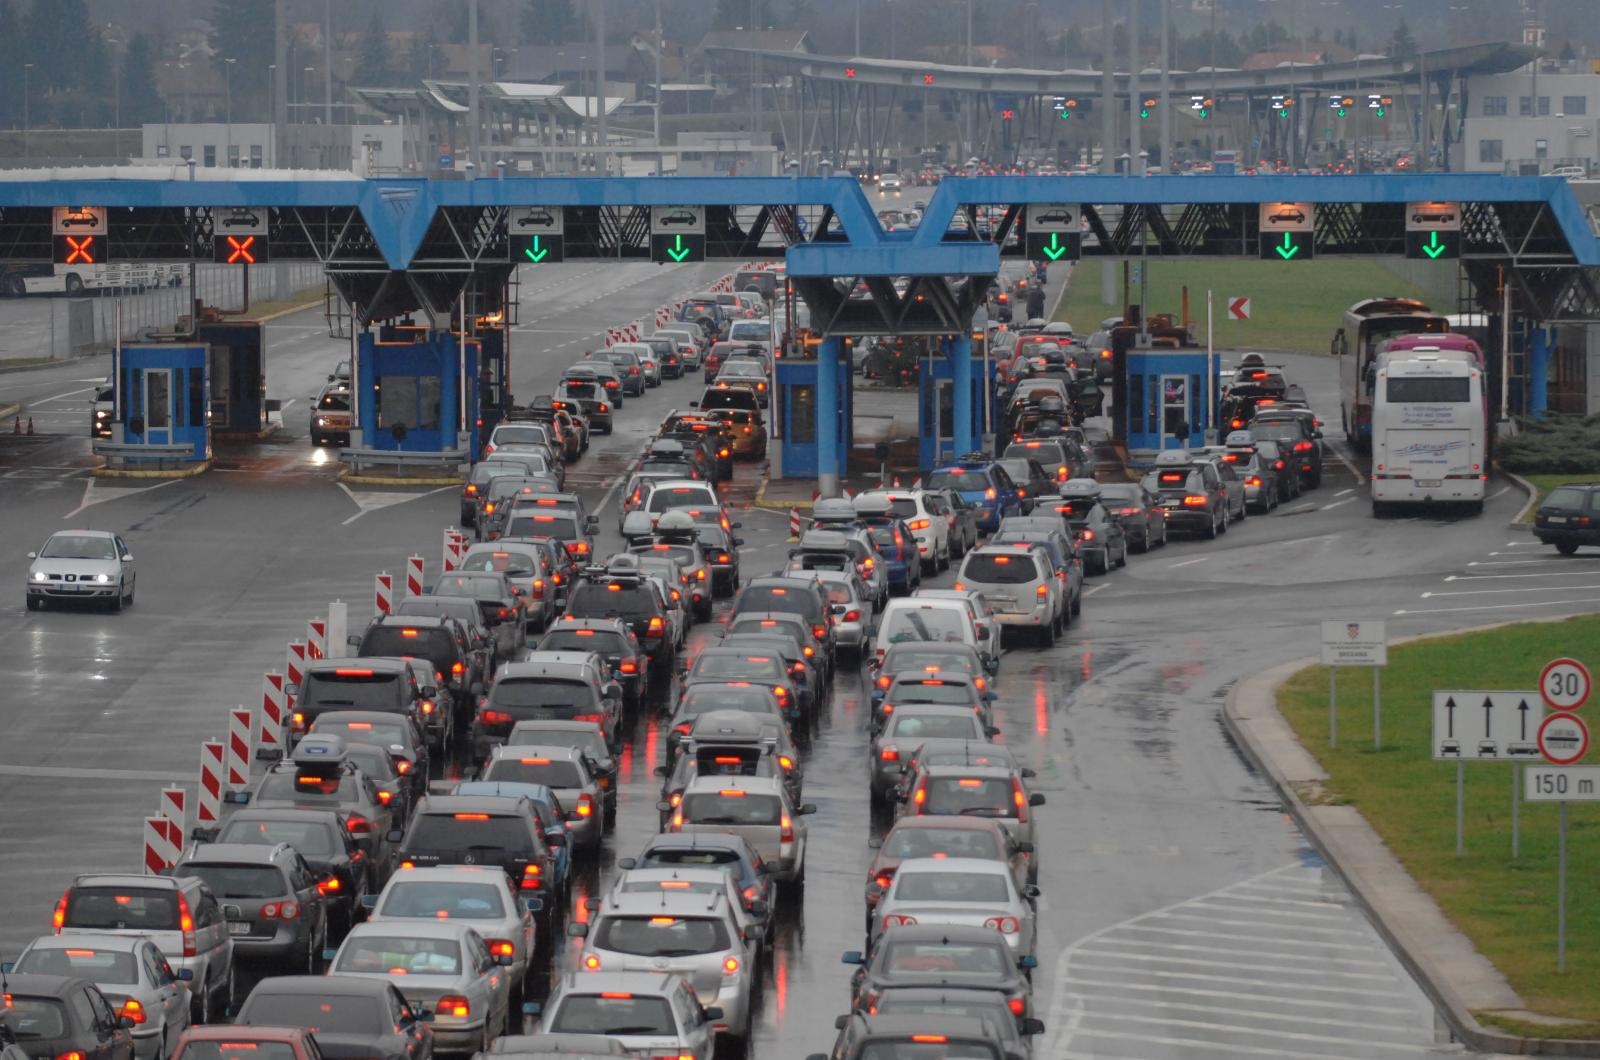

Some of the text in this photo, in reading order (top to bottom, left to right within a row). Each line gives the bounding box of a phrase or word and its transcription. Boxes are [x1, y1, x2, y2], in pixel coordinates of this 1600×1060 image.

[1551, 672, 1578, 696] 30
[1535, 774, 1594, 794] 150 m
